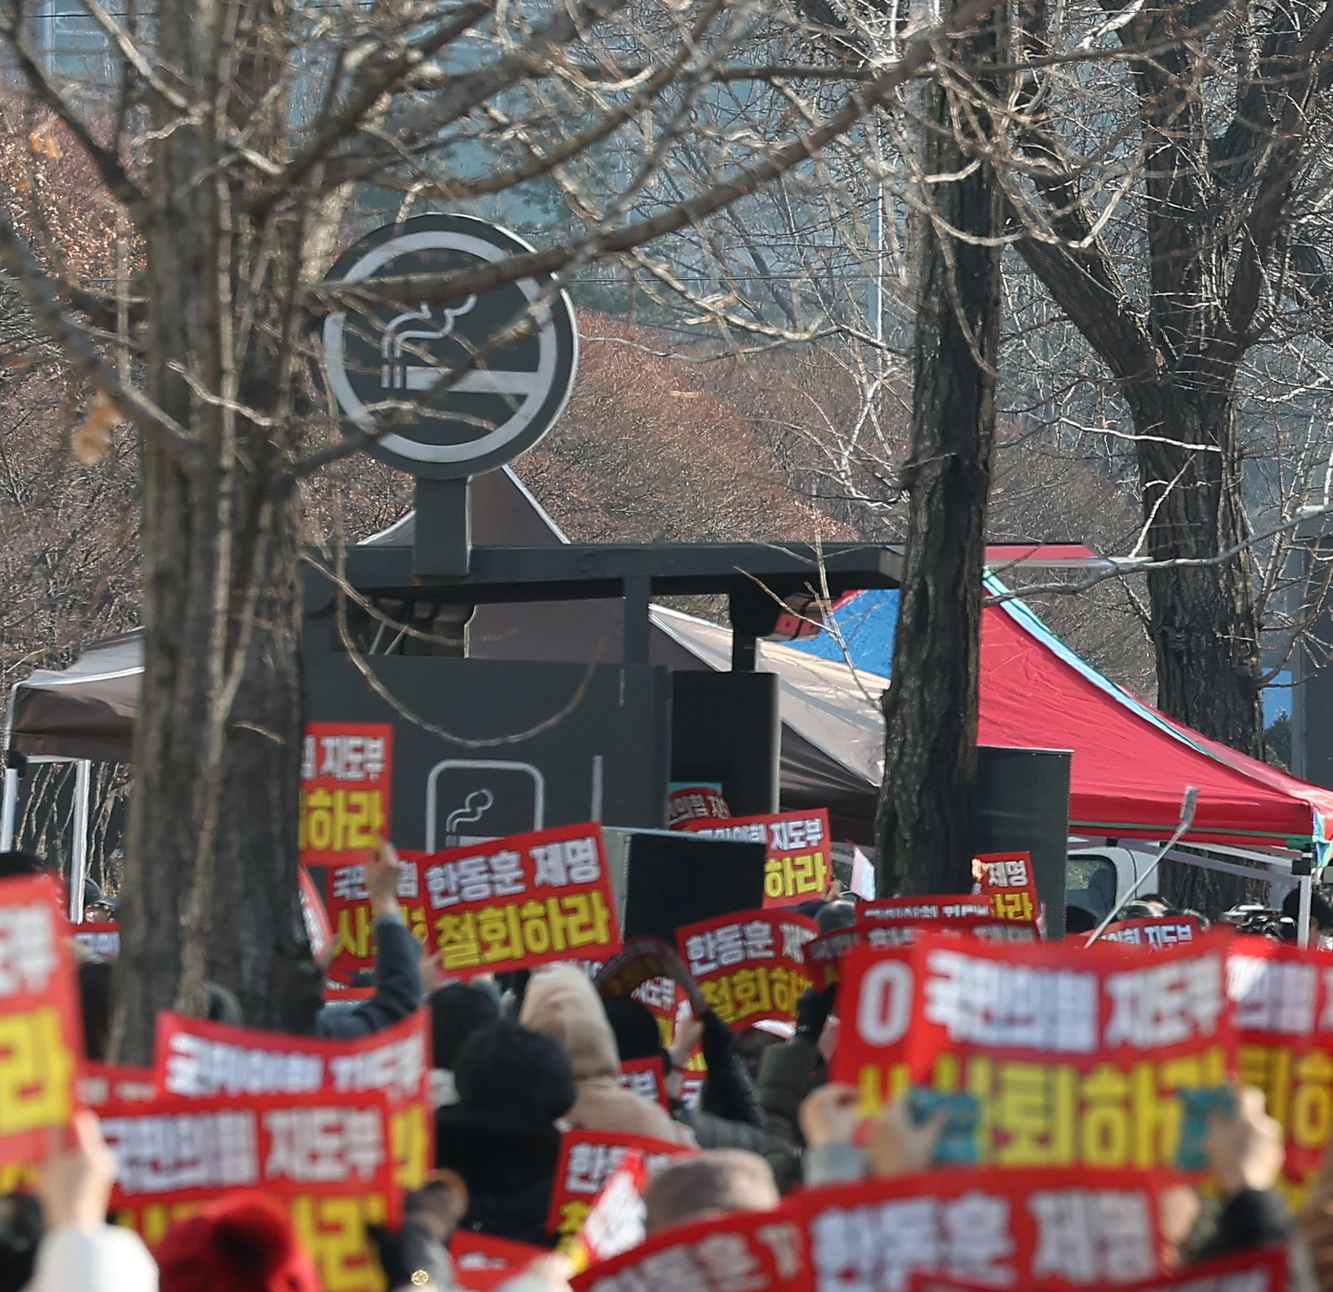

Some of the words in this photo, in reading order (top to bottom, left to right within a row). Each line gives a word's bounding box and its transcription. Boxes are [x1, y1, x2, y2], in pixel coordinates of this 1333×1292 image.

[320, 734, 388, 782] 지도부
[769, 818, 824, 851] 지도부
[424, 852, 527, 911] 한동훈
[528, 835, 602, 889] 제명
[434, 889, 612, 972] 철회하라
[684, 920, 776, 978] 한동훈
